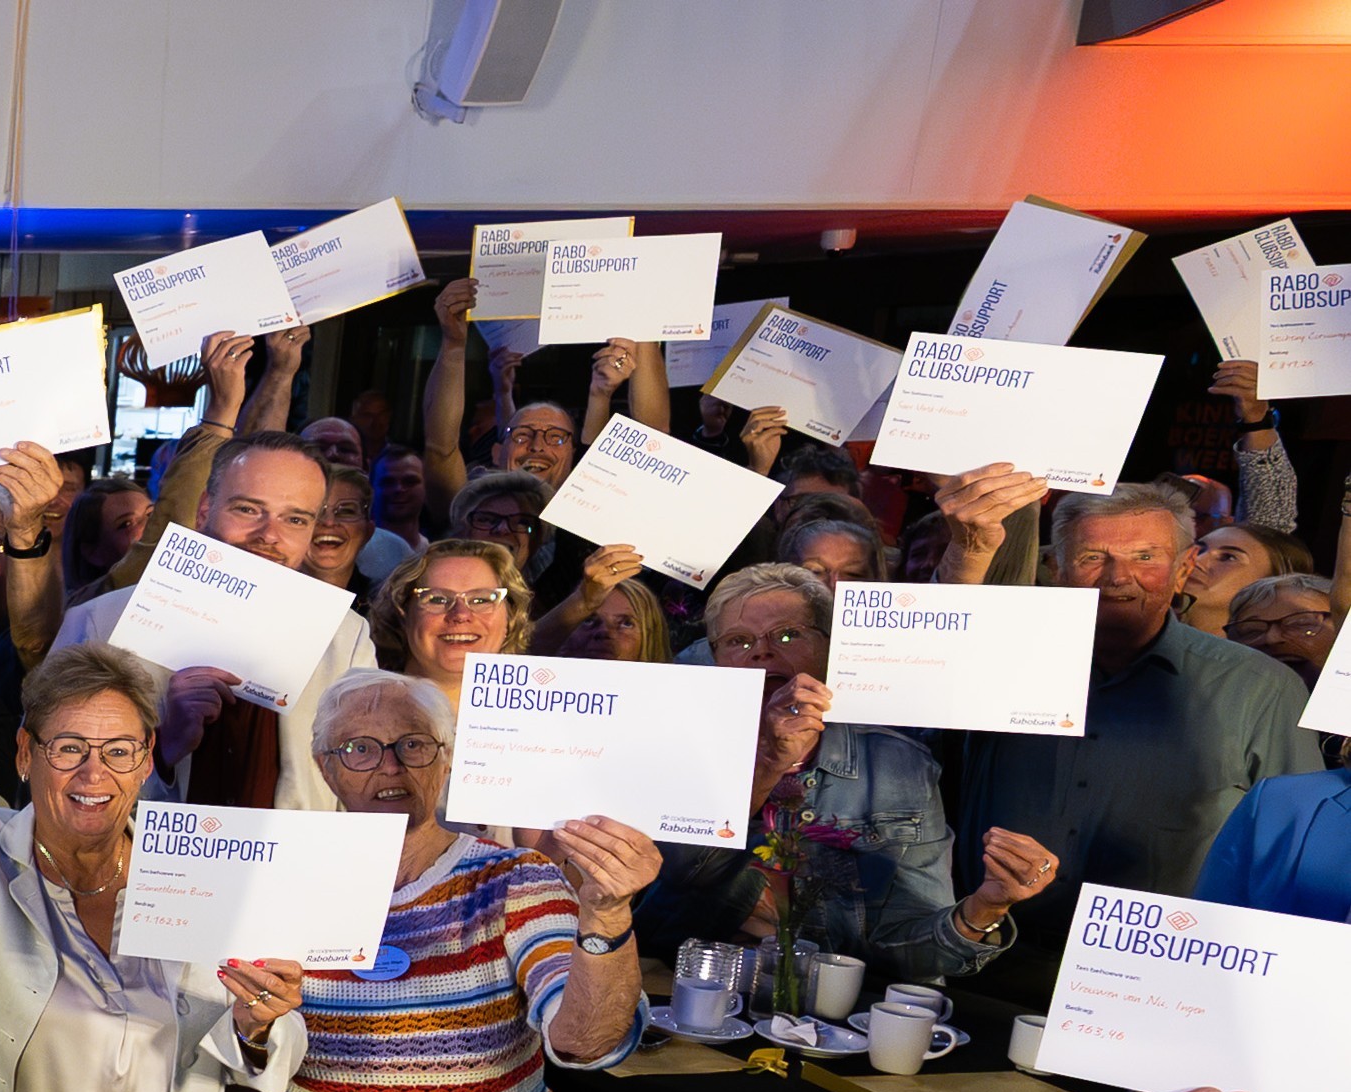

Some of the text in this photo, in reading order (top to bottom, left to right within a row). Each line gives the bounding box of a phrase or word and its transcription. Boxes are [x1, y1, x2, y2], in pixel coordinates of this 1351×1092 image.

[481, 230, 510, 243] RABO
[1271, 223, 1297, 251] RABO
[272, 242, 298, 262] RABO
[276, 237, 342, 273] CLUBSUPPORT
[479, 240, 550, 257] CLUBSUPPOR
[553, 245, 586, 259] RABO
[1254, 231, 1289, 270] CLUBSUP
[552, 257, 638, 274] CLUBSUPPORT
[122, 268, 155, 289] RABO
[128, 265, 206, 301] CLUBSUPPORT
[1270, 273, 1319, 293] RABO
[967, 279, 1008, 338] BSUPPORT
[1270, 289, 1350, 311] CLUBSUP
[767, 314, 798, 336] RABO
[757, 326, 830, 363] CLUBSUPPORT
[913, 341, 963, 361] RABO
[908, 360, 1034, 389] CLUBSUPPORT
[608, 422, 647, 448] RABO
[598, 437, 690, 487] CLUBSUPPORT
[166, 532, 207, 559] RABO
[158, 550, 257, 600] CLUBSUPPORT
[844, 590, 892, 608] RABO
[842, 609, 972, 631] CLUBSUPPORT
[474, 663, 529, 685] RABO
[470, 687, 618, 715] CLUBSUPPORT
[146, 810, 197, 833] RABO
[659, 822, 714, 836] Rabobank
[142, 833, 279, 863] CLUBSUPPORT
[1088, 896, 1163, 929] RABO
[306, 953, 350, 963] Rabobank
[1082, 922, 1279, 977] CLUBSUPPORT
[1069, 981, 1118, 999] Vrouwen
[1176, 1000, 1206, 1019] Ingen
[1077, 1023, 1126, 1041] 163,46
